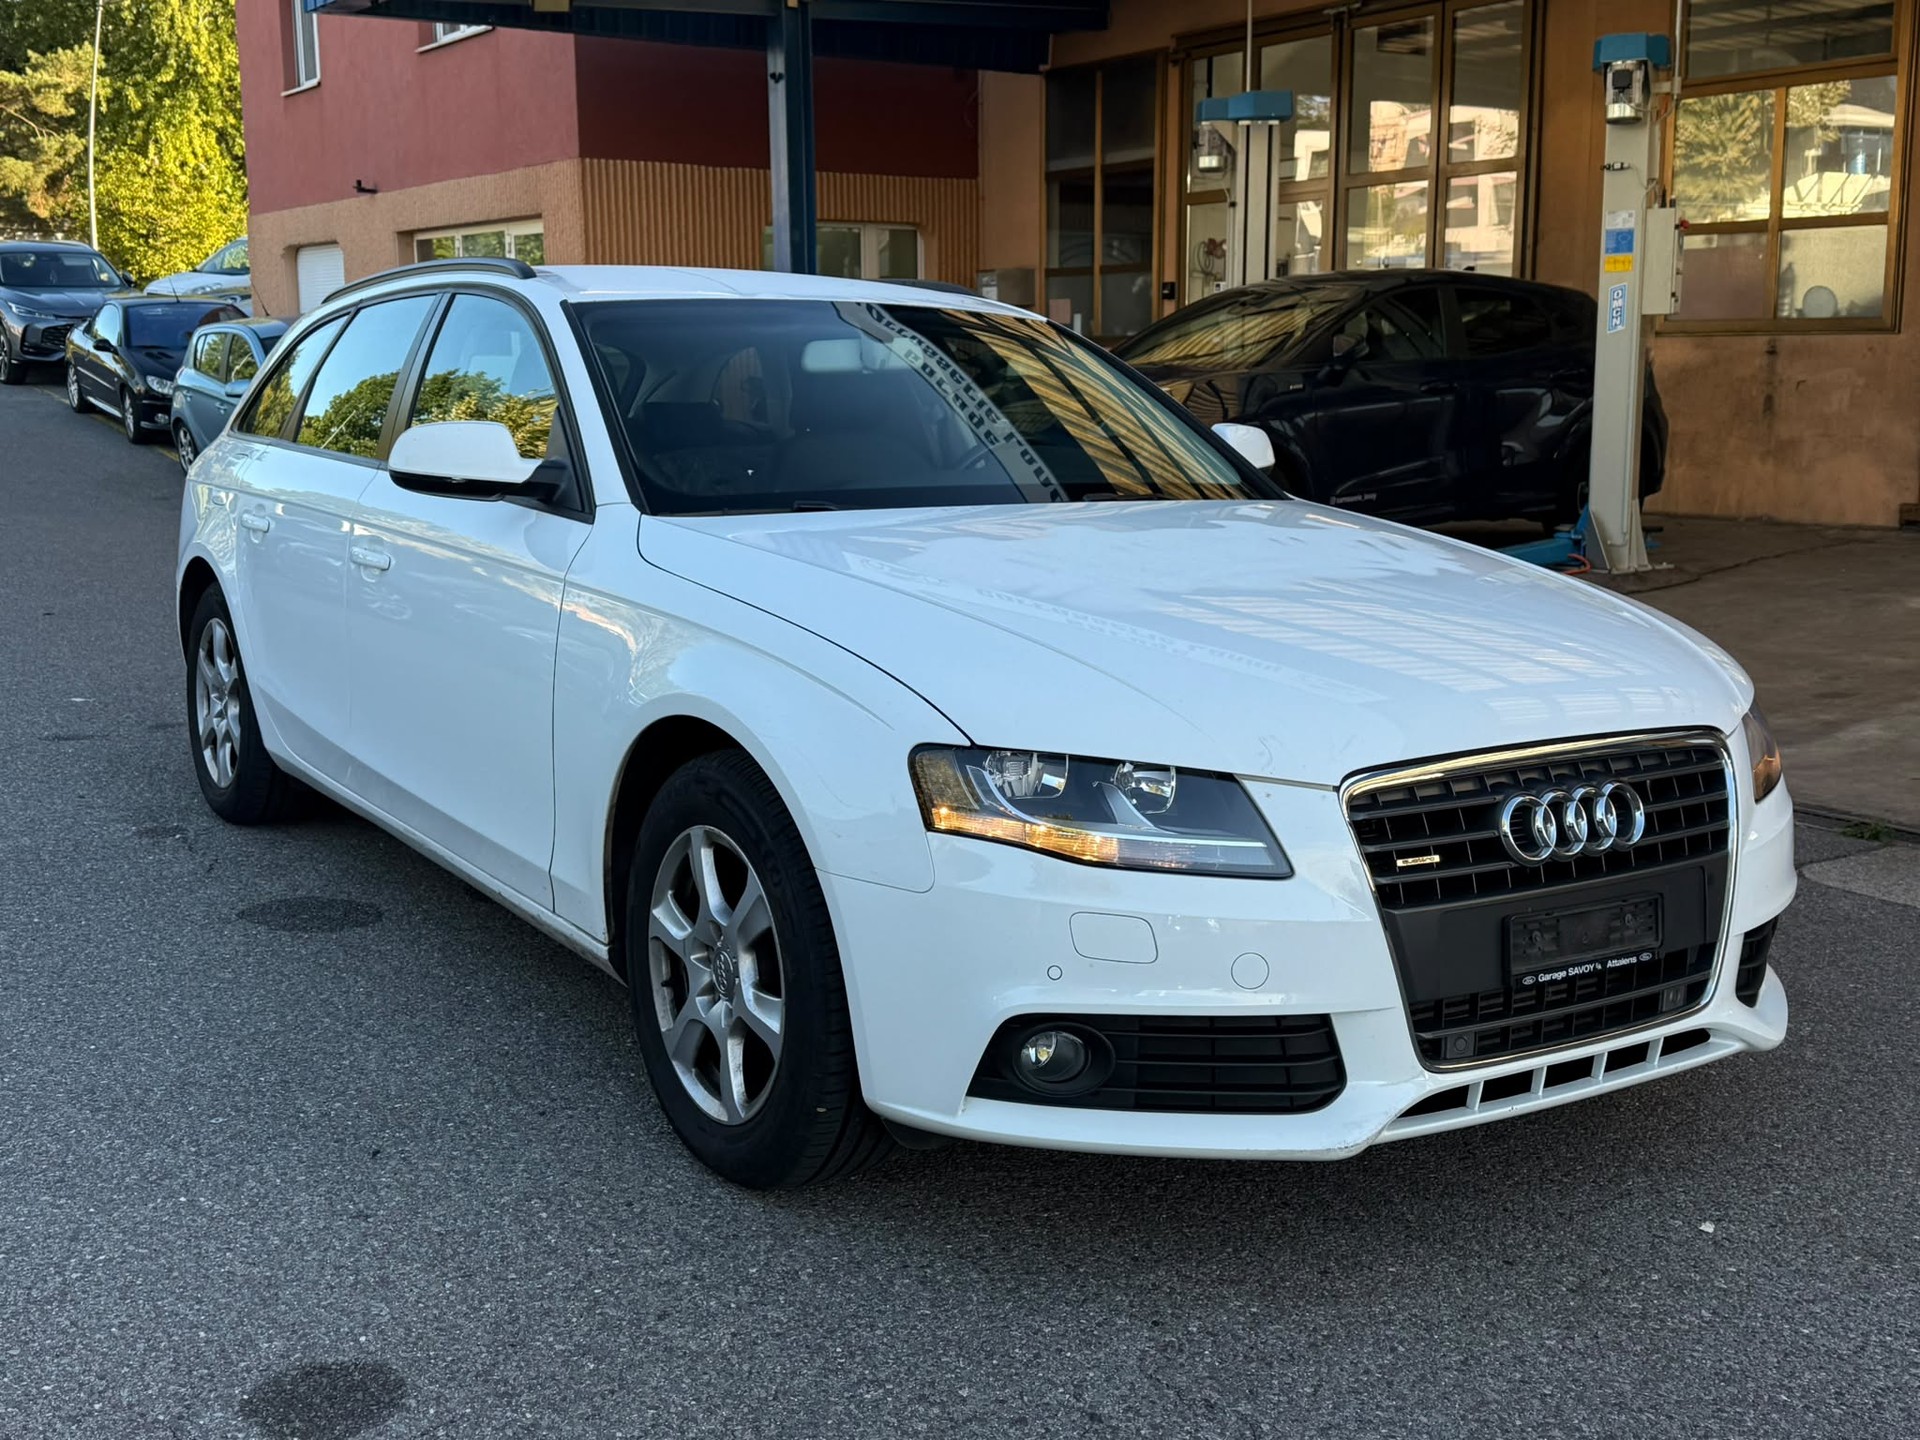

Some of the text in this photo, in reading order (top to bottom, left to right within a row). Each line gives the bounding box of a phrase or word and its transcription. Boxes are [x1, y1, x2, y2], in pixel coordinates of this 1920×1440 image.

[1612, 289, 1624, 327] OMCN
[1538, 970, 1567, 982] Garage
[1568, 963, 1595, 976] SAVOY
[1606, 956, 1638, 968] Attalens
